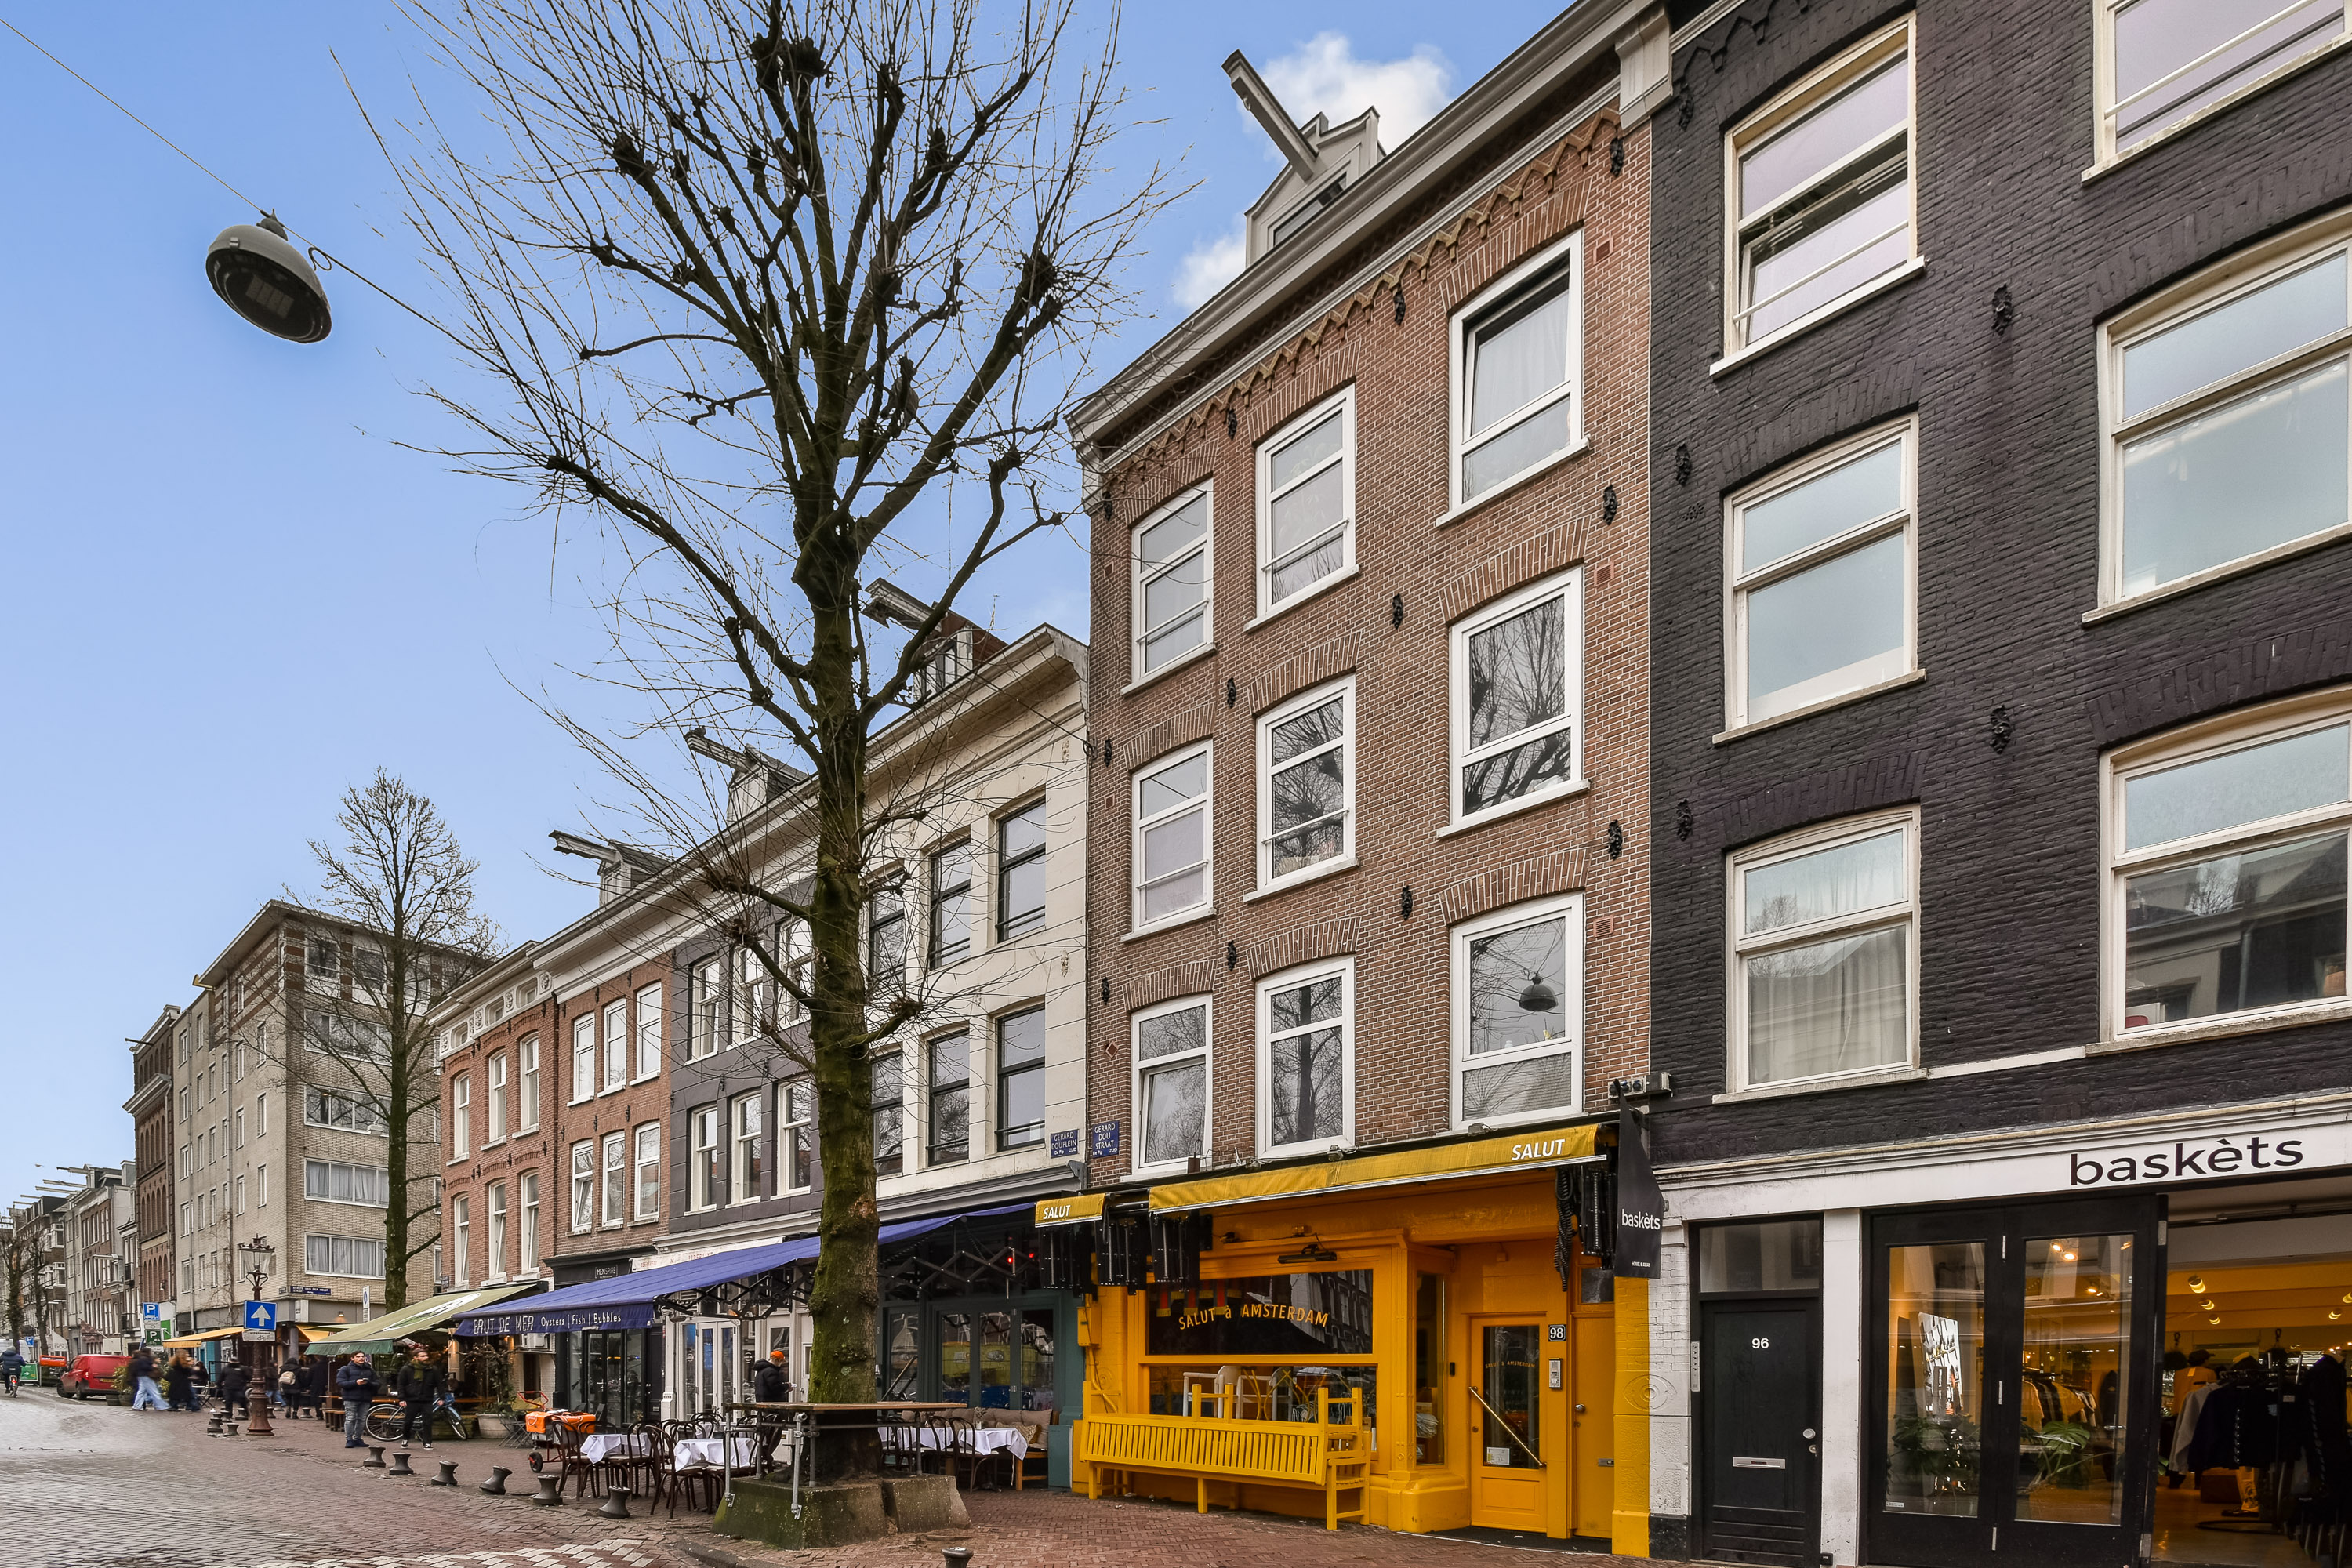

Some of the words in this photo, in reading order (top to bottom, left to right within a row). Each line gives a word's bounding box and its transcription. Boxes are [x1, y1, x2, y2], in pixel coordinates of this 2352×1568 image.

[1094, 1123, 1115, 1133] GERARD
[1054, 1132, 1074, 1141] GERARD
[1098, 1132, 1111, 1141] DOU
[1051, 1139, 1077, 1150] DOUPLEIN
[1095, 1140, 1114, 1150] STRAAT
[1511, 1138, 1566, 1160] SALUT
[2070, 1136, 2303, 1185] baskèts
[1043, 1204, 1071, 1219] SALUT
[1621, 1208, 1661, 1230] baskèts
[597, 1266, 616, 1276] MENSPIRE
[146, 1304, 156, 1313] P
[1178, 1307, 1215, 1330] SALUT
[1225, 1305, 1232, 1319] à
[1241, 1303, 1329, 1327] AMSTERDAM
[474, 1318, 495, 1334] BRUT
[499, 1316, 510, 1333] DE
[515, 1315, 534, 1331] MER
[540, 1316, 565, 1330] Oysters
[572, 1314, 586, 1325] Fish
[593, 1311, 622, 1323] Bubbles
[1549, 1327, 1564, 1339] 98
[1751, 1338, 1769, 1349] 96
